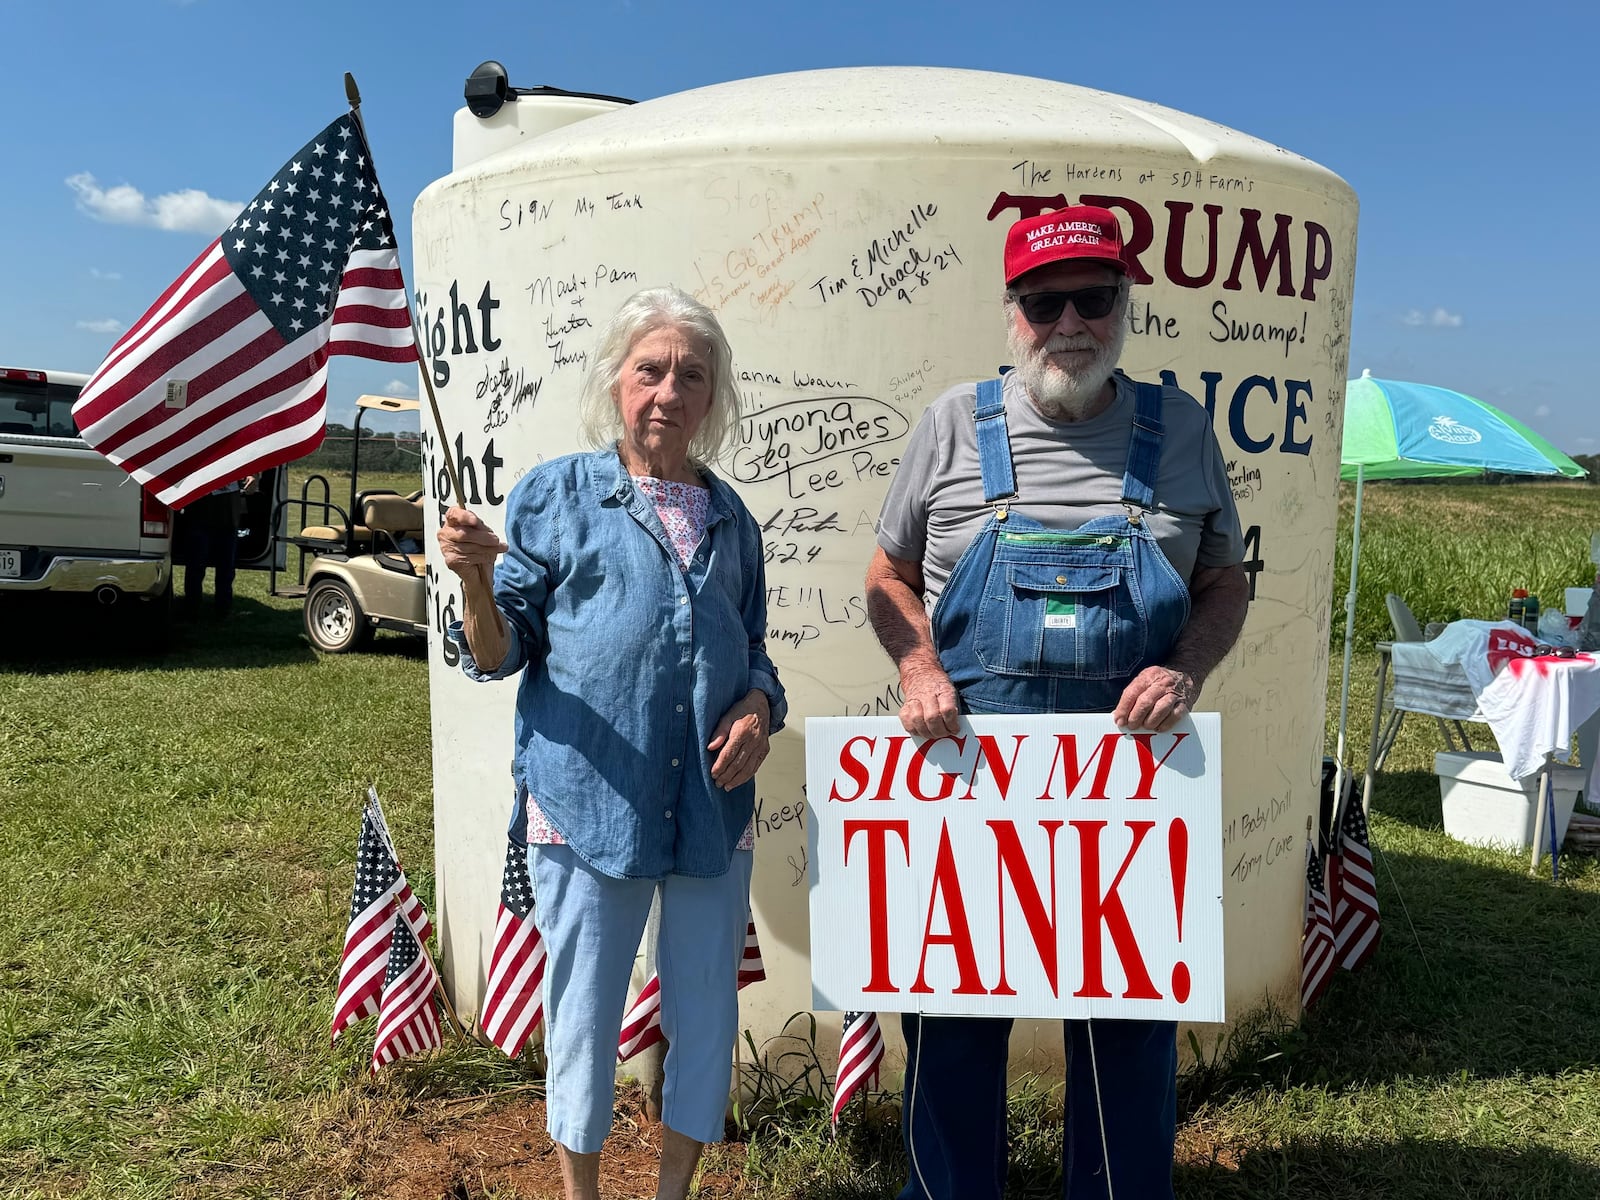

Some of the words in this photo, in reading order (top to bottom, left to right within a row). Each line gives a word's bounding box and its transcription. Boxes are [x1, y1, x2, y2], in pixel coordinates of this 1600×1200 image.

[1012, 160, 1052, 188] The
[1066, 163, 1122, 182] Hardens
[1139, 173, 1156, 184] at
[1171, 170, 1203, 188] SDH
[1209, 176, 1255, 193] Farm's
[1026, 224, 1055, 242] MAKE
[1056, 221, 1102, 235] AMERICA
[1030, 235, 1065, 252] GREAT
[1066, 233, 1100, 245] AGAIN
[809, 275, 848, 303] Tim
[867, 203, 938, 276] Michelle
[595, 264, 637, 288] Pam
[1127, 302, 1181, 338] the
[1209, 300, 1308, 358] Swamp!
[736, 363, 781, 383] ianne
[800, 416, 889, 454] Jones
[786, 461, 843, 498] Lee
[1226, 460, 1238, 472] or
[819, 588, 869, 629] LiS
[766, 623, 820, 649] ump
[828, 735, 1030, 802] SIGN
[1036, 733, 1191, 800] MY
[754, 798, 805, 838] Keep
[1223, 819, 1236, 849] ill
[843, 816, 1192, 1004] TANK!
